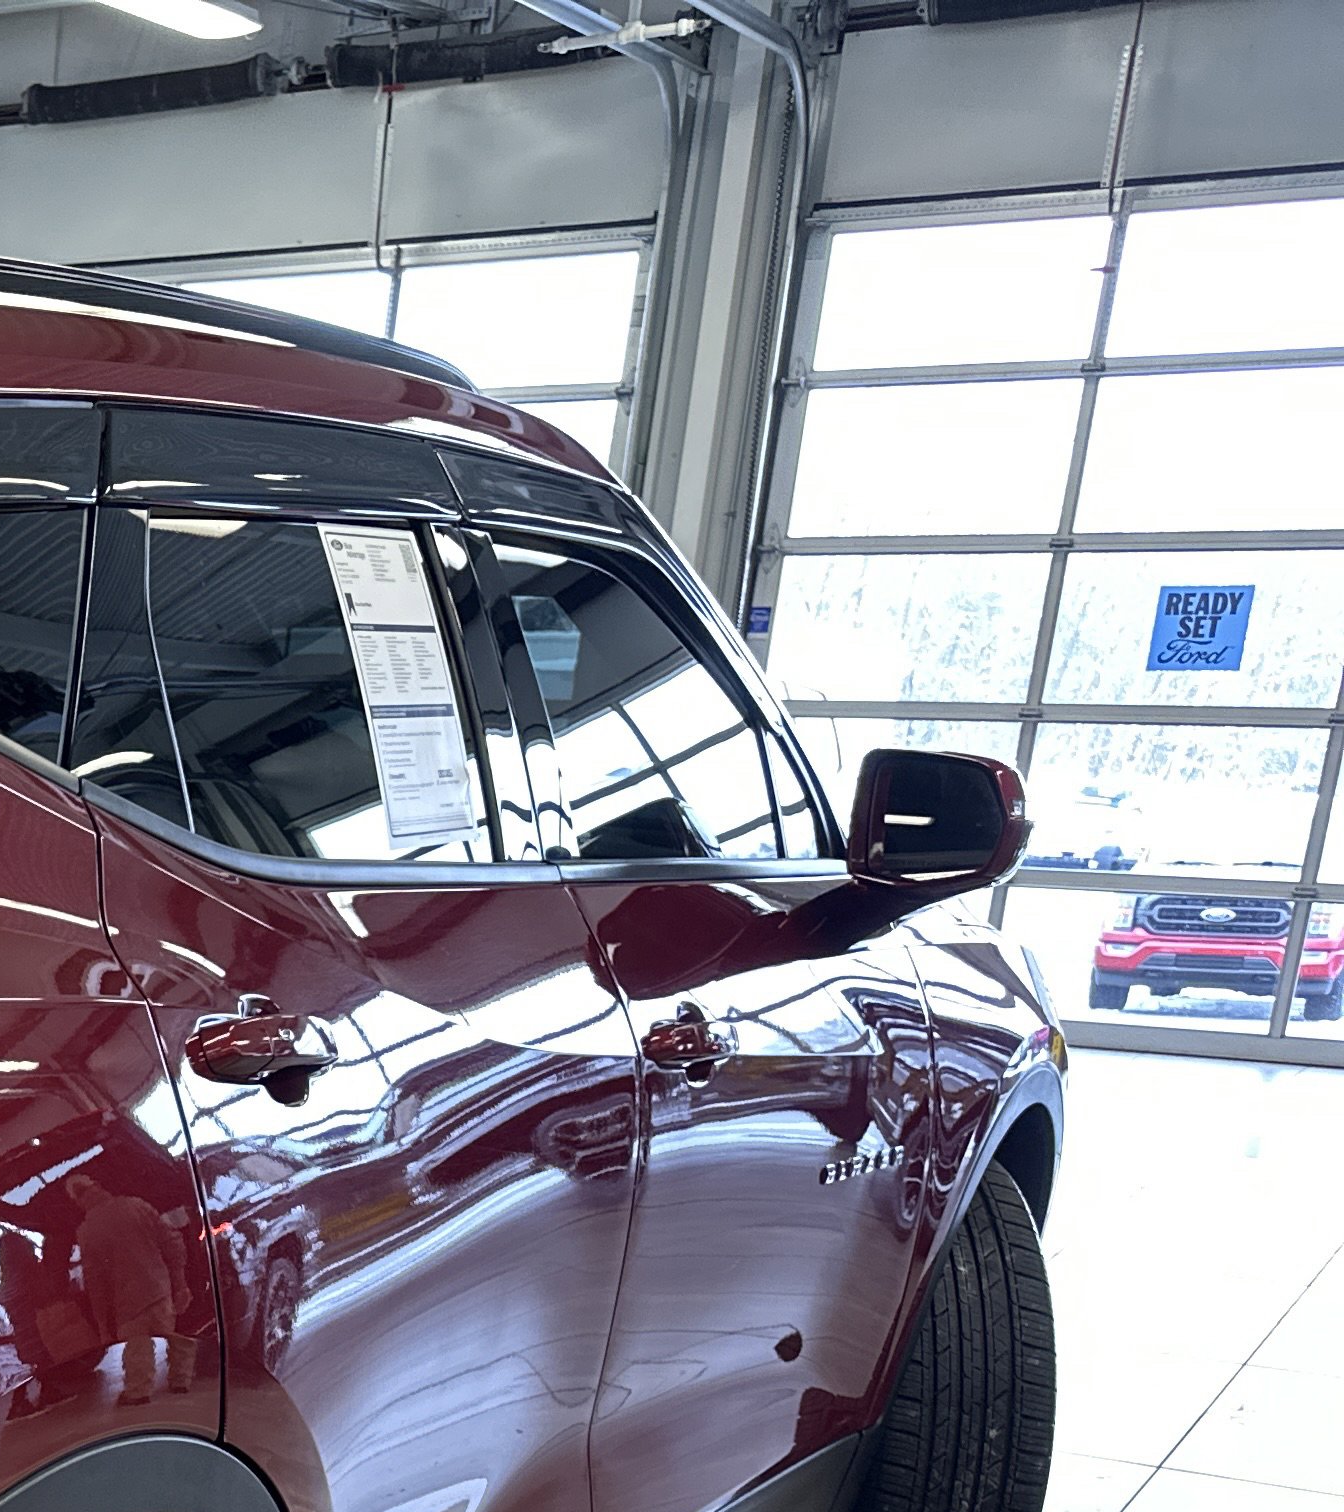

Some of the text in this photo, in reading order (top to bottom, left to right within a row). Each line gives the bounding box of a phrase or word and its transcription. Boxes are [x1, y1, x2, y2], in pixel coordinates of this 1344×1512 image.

[1165, 592, 1244, 616] READY
[1177, 616, 1221, 638] SET
[1157, 638, 1236, 665] Ford
